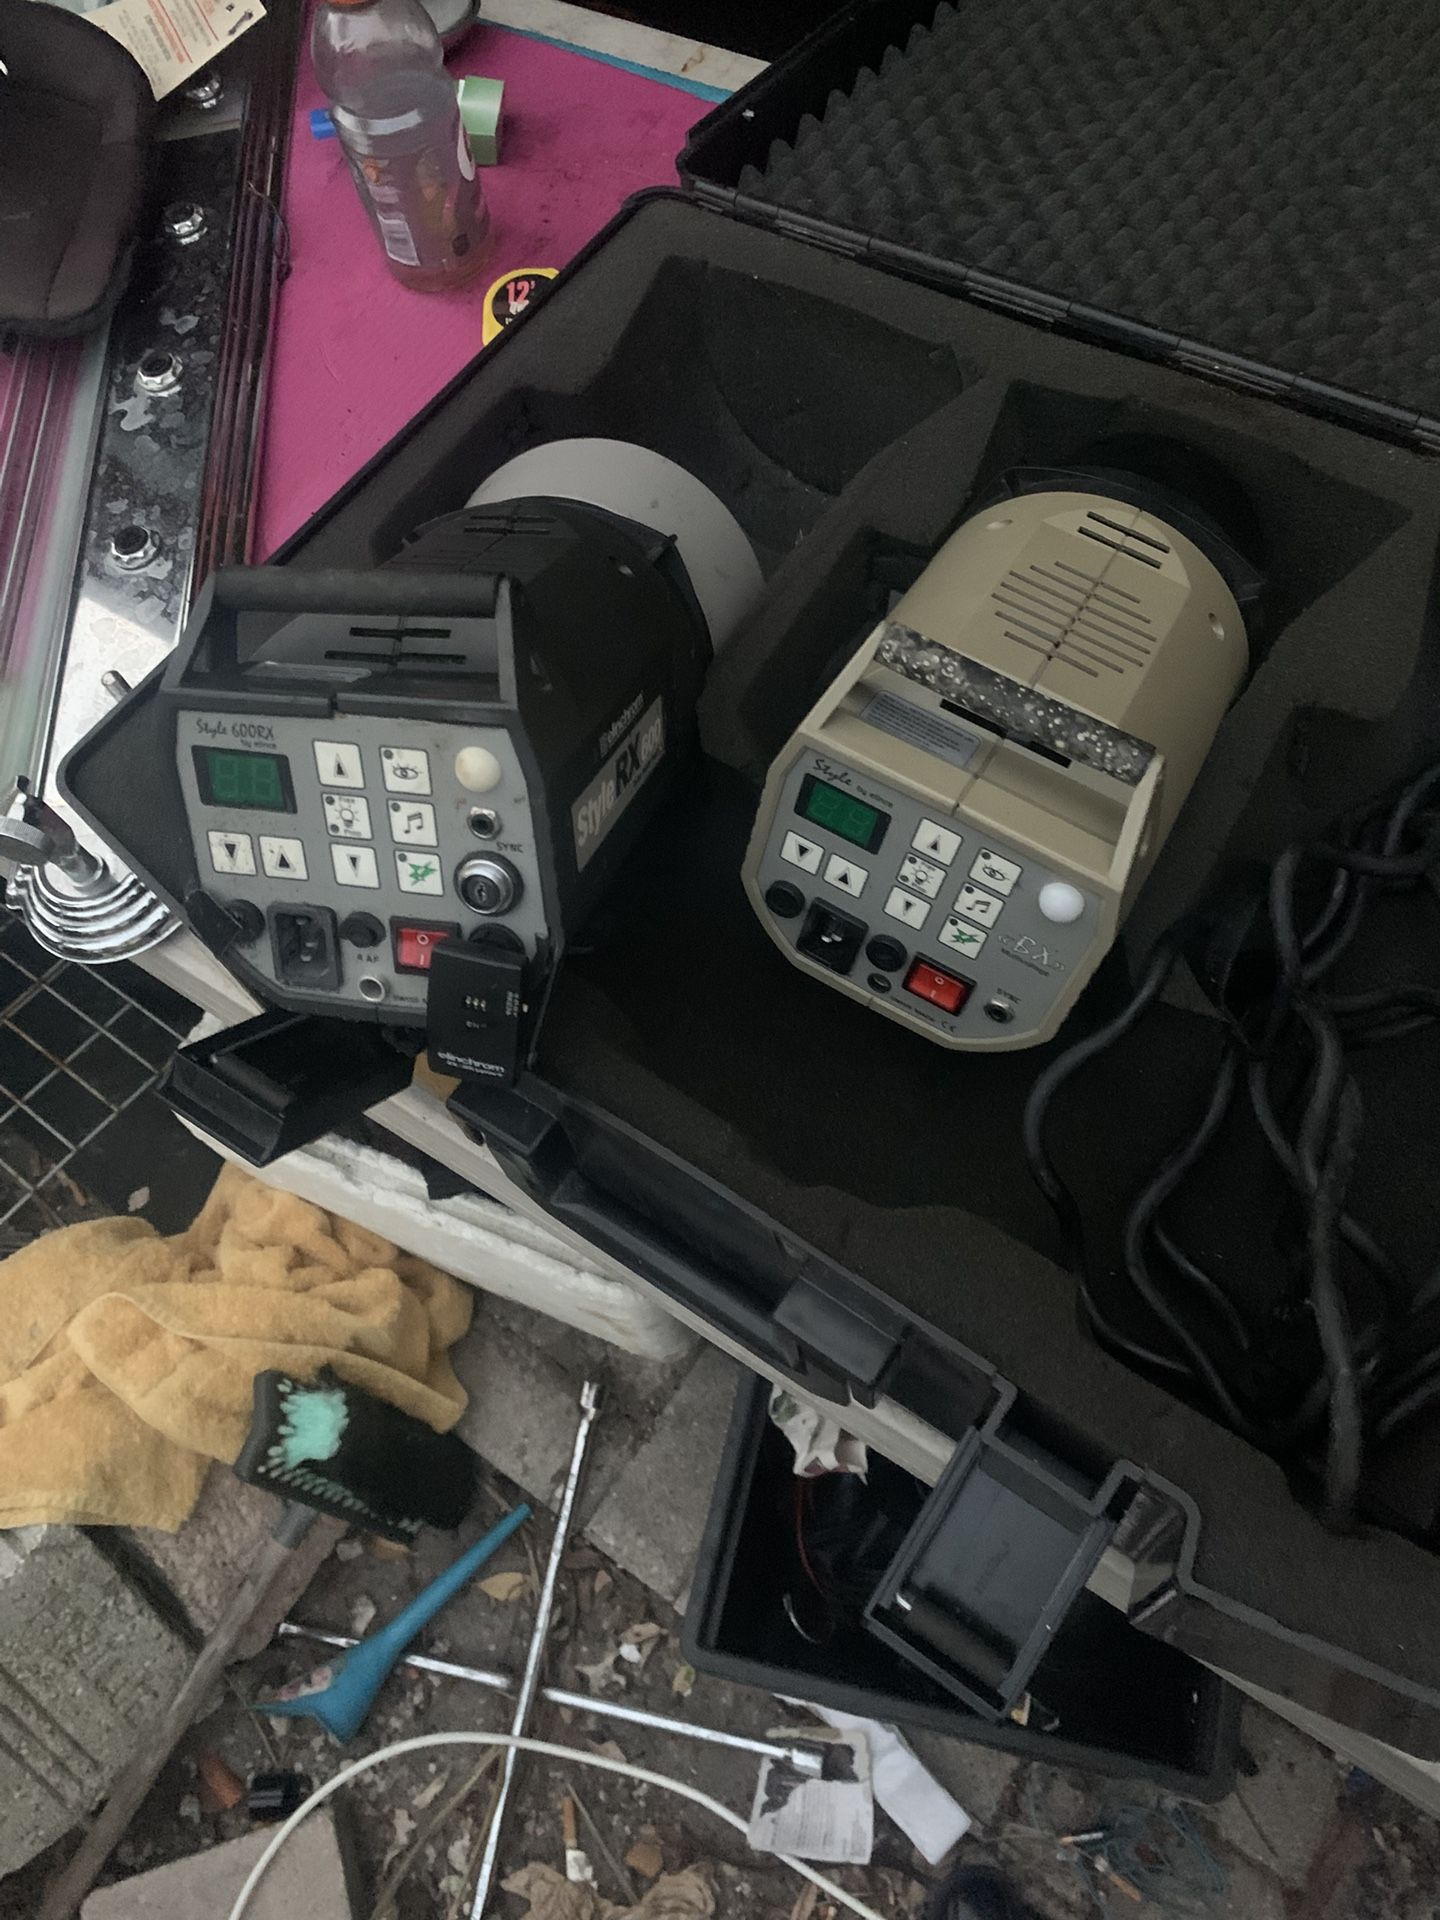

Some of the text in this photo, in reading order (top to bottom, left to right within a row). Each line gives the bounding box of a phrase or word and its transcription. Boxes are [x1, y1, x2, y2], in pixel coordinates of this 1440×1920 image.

[196, 718, 275, 740] Style 600RX
[813, 759, 852, 786] Style
[437, 1051, 506, 1074] elinchrom
